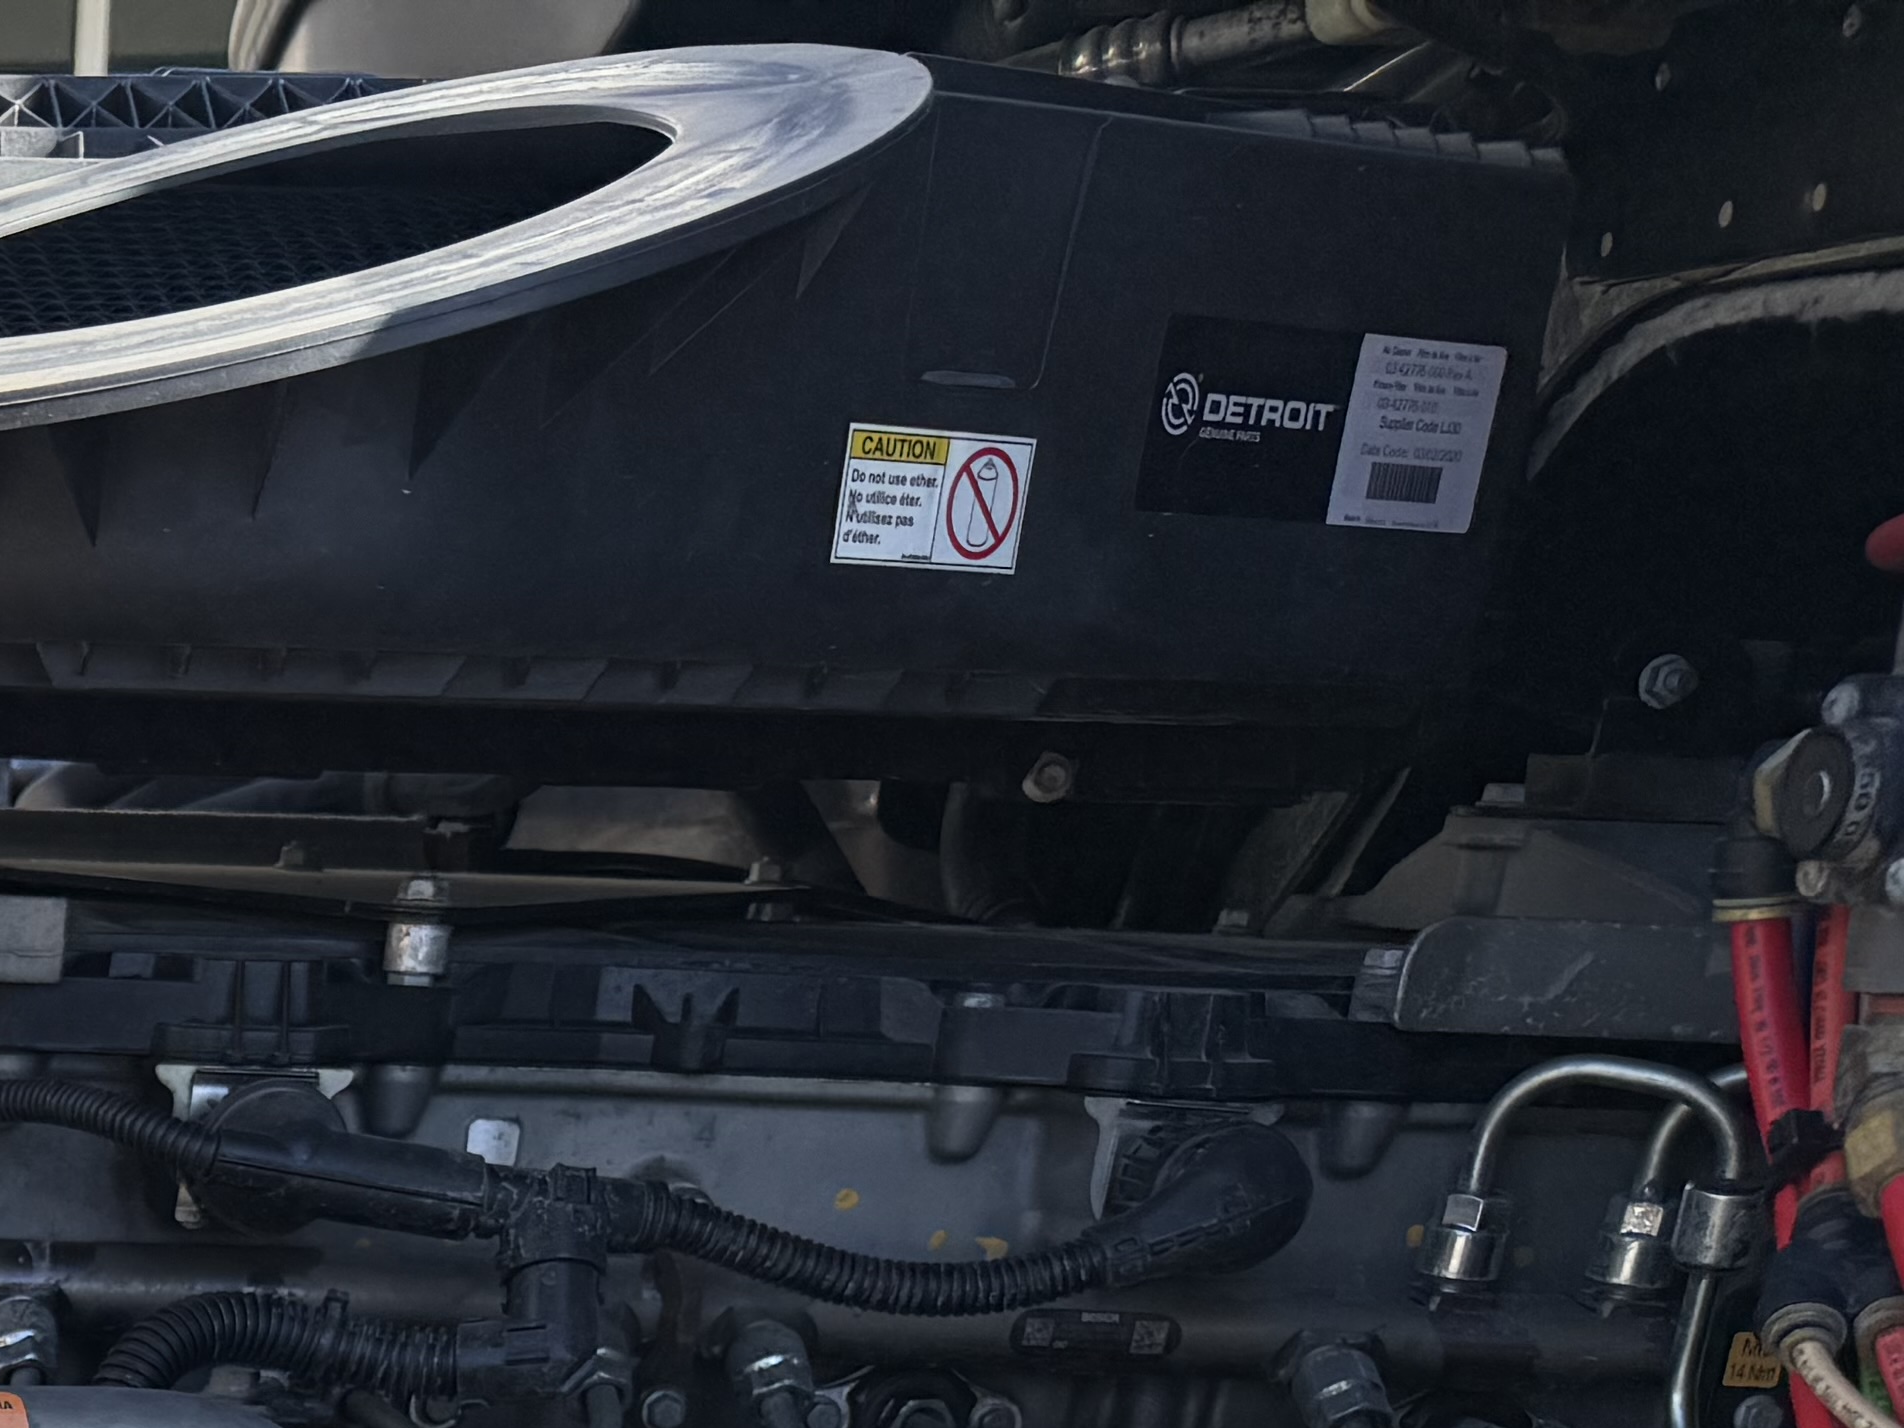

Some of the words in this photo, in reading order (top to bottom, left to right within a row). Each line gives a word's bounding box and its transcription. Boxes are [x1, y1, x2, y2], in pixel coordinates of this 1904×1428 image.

[1203, 393, 1336, 431] DETROIT
[1415, 418, 1440, 433] Code
[861, 435, 936, 460] CAUTION
[851, 468, 864, 482] Do
[868, 471, 886, 484] not
[888, 473, 907, 486] use
[910, 474, 939, 488] ether.
[849, 489, 863, 503] No
[895, 514, 914, 528] pas
